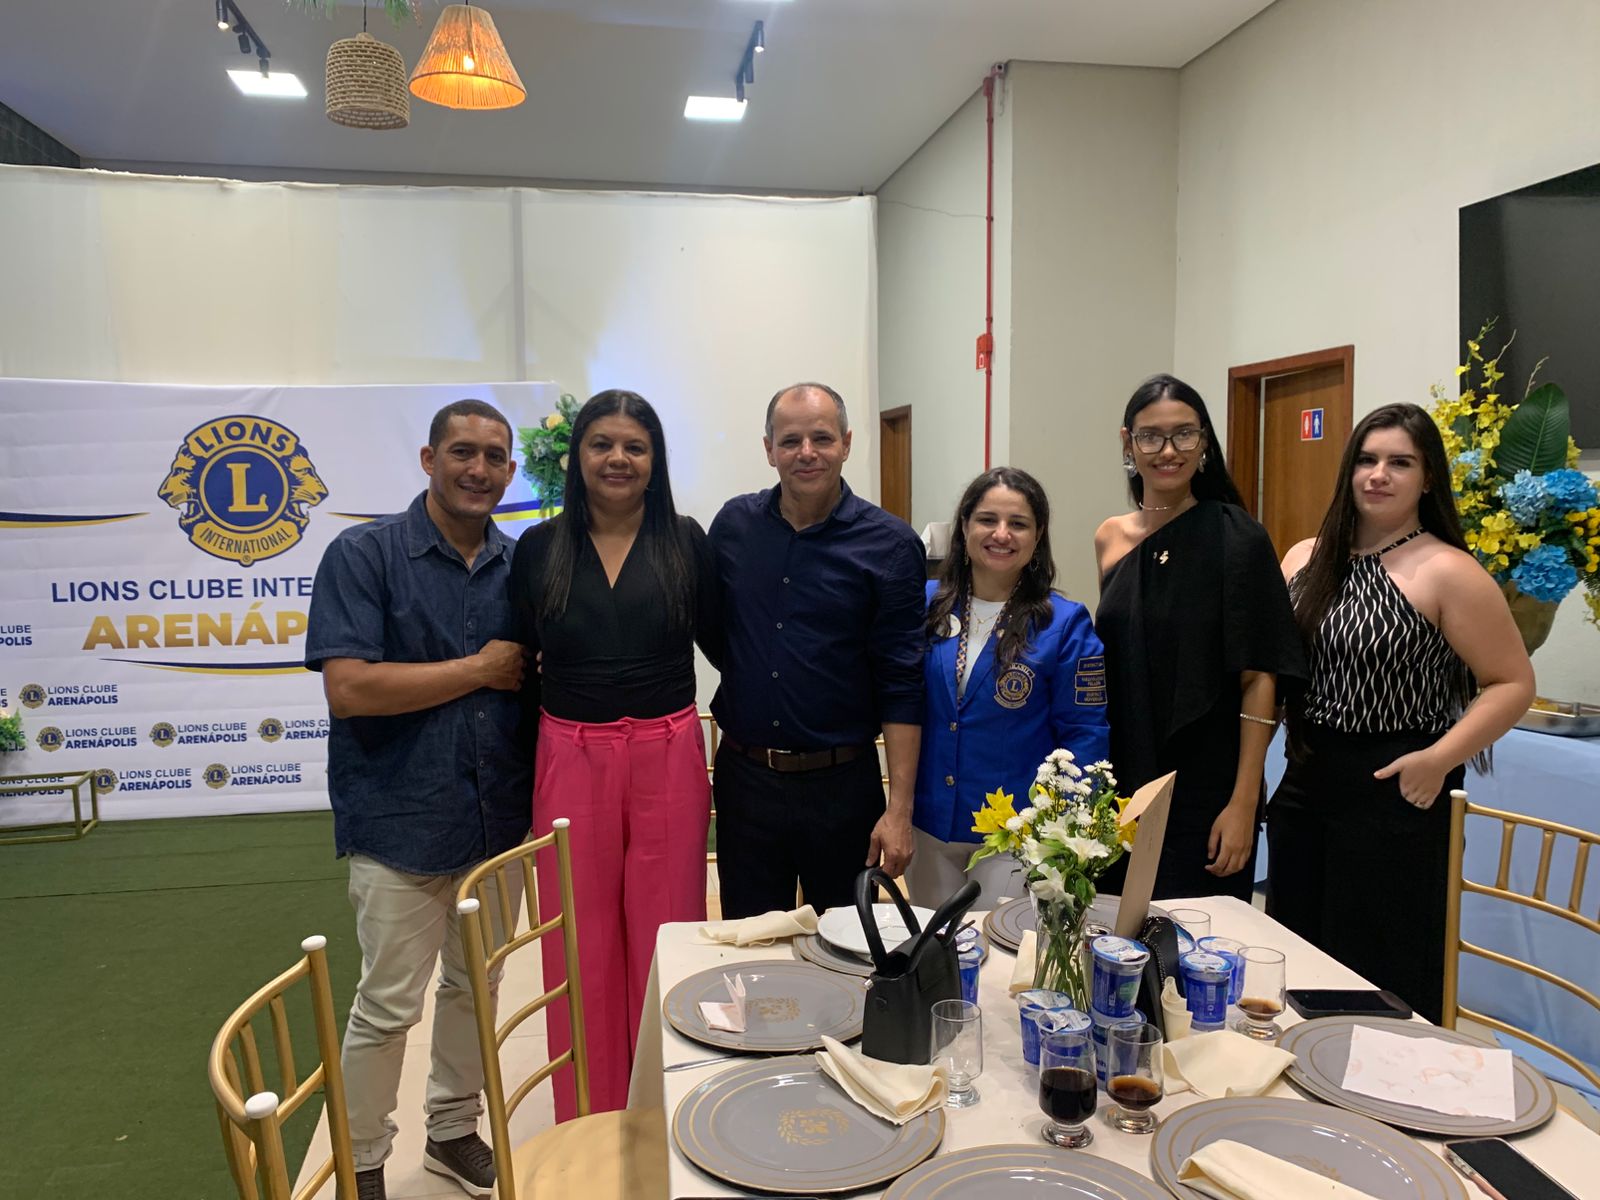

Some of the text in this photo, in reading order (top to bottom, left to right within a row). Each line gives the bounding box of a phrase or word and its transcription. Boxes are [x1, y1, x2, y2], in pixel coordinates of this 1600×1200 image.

[194, 421, 290, 453] LIONS
[226, 463, 269, 512] L
[200, 527, 292, 554] INTERNATIONAL
[52, 577, 312, 602] LIONS CLUBE INTE
[82, 602, 307, 650] ARENÁP
[48, 684, 118, 695] LIONS CLUBE
[47, 695, 118, 706] ARENÁPOLIS
[178, 722, 247, 733] LIONS CLUBE
[285, 720, 315, 728] LIONS
[65, 727, 136, 737] LIONS CLUBE
[177, 732, 247, 744] ARENÁPOLIS
[65, 737, 137, 749] ARENÁPOLIS
[120, 768, 191, 779] LIONS CLUBE
[231, 763, 301, 774] LIONS CLUBE
[119, 778, 192, 791] ARENÁPOLIS
[231, 773, 302, 786] ARENÁPOLIS
